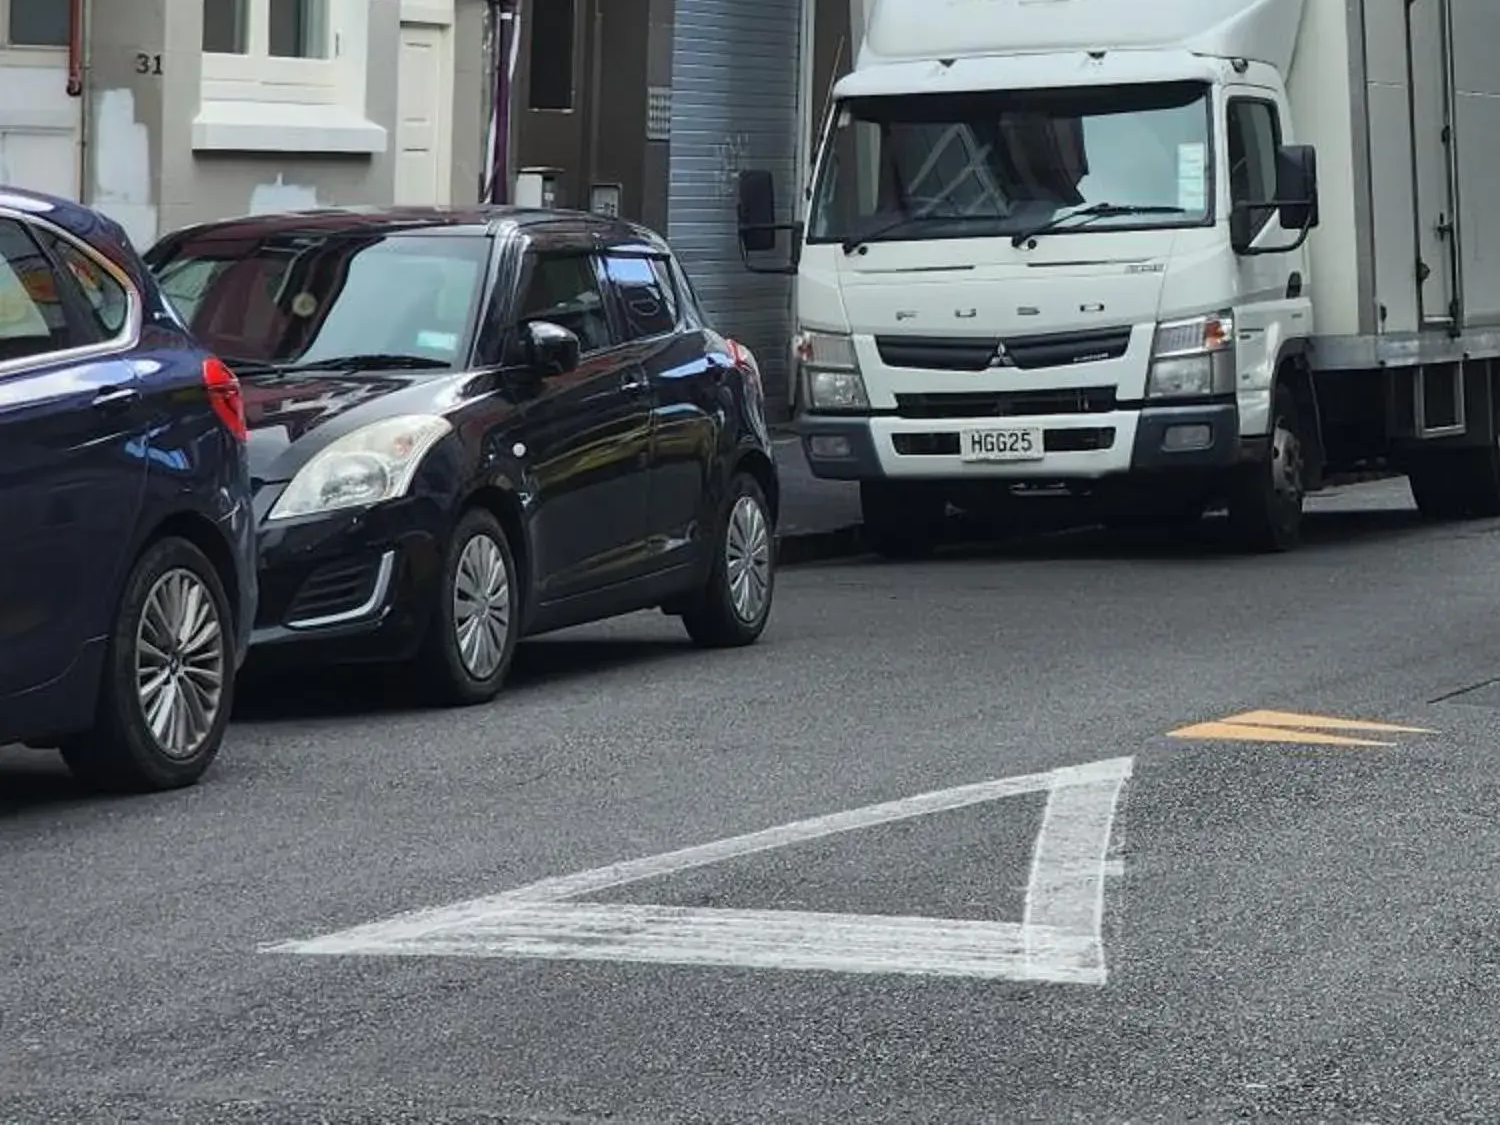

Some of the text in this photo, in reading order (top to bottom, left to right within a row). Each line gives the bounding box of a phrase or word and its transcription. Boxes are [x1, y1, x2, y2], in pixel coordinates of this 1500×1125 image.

[135, 52, 164, 76] 31
[894, 301, 1106, 322] FUSO
[970, 431, 1034, 454] HGG25
